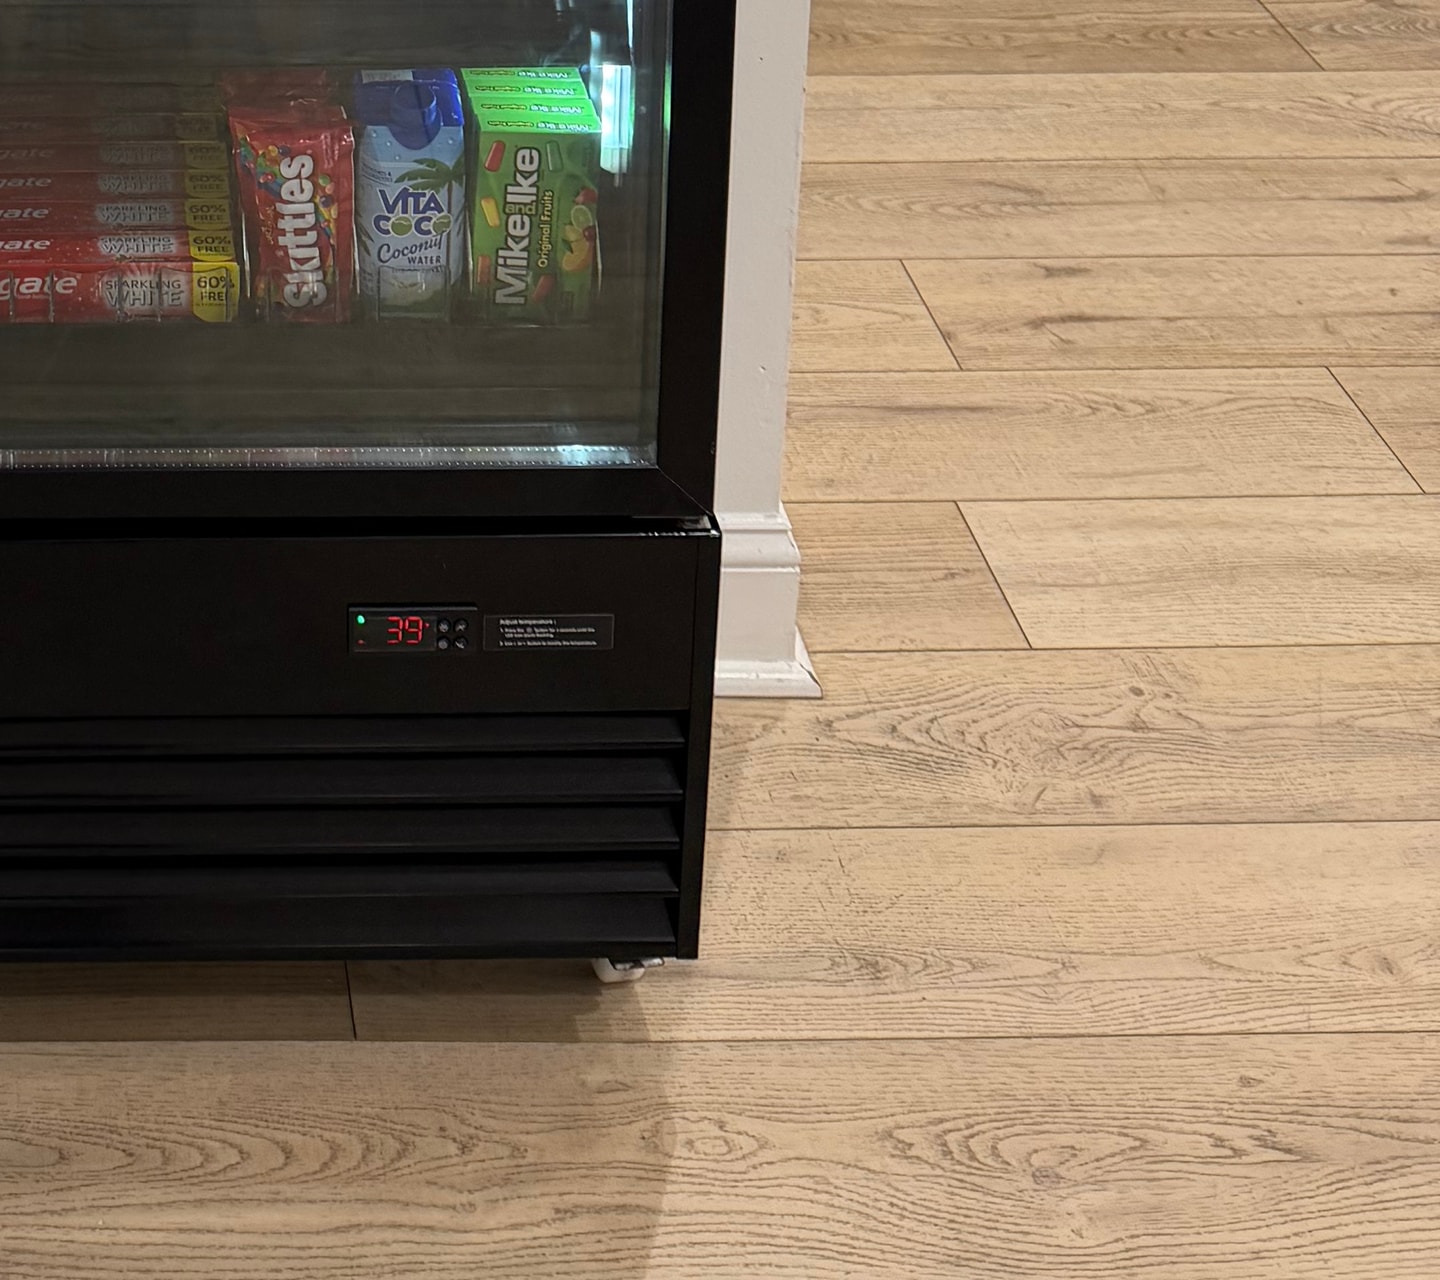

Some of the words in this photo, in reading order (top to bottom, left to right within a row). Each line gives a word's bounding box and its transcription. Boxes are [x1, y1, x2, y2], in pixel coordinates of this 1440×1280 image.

[505, 146, 541, 205] Ike
[188, 203, 226, 214] 60%
[378, 186, 445, 215] VITA
[505, 201, 537, 216] and
[540, 189, 554, 222] Fruits
[372, 213, 452, 238] COCO
[101, 243, 174, 254] WHITE
[193, 235, 231, 245] 60%
[197, 245, 229, 253] FREE
[377, 234, 444, 264] Coconut
[537, 222, 555, 269] Original
[407, 254, 442, 265] WATER
[495, 214, 531, 306] Mike
[196, 275, 235, 290] 60%
[103, 290, 184, 308] WHITE
[386, 615, 423, 645] 39
